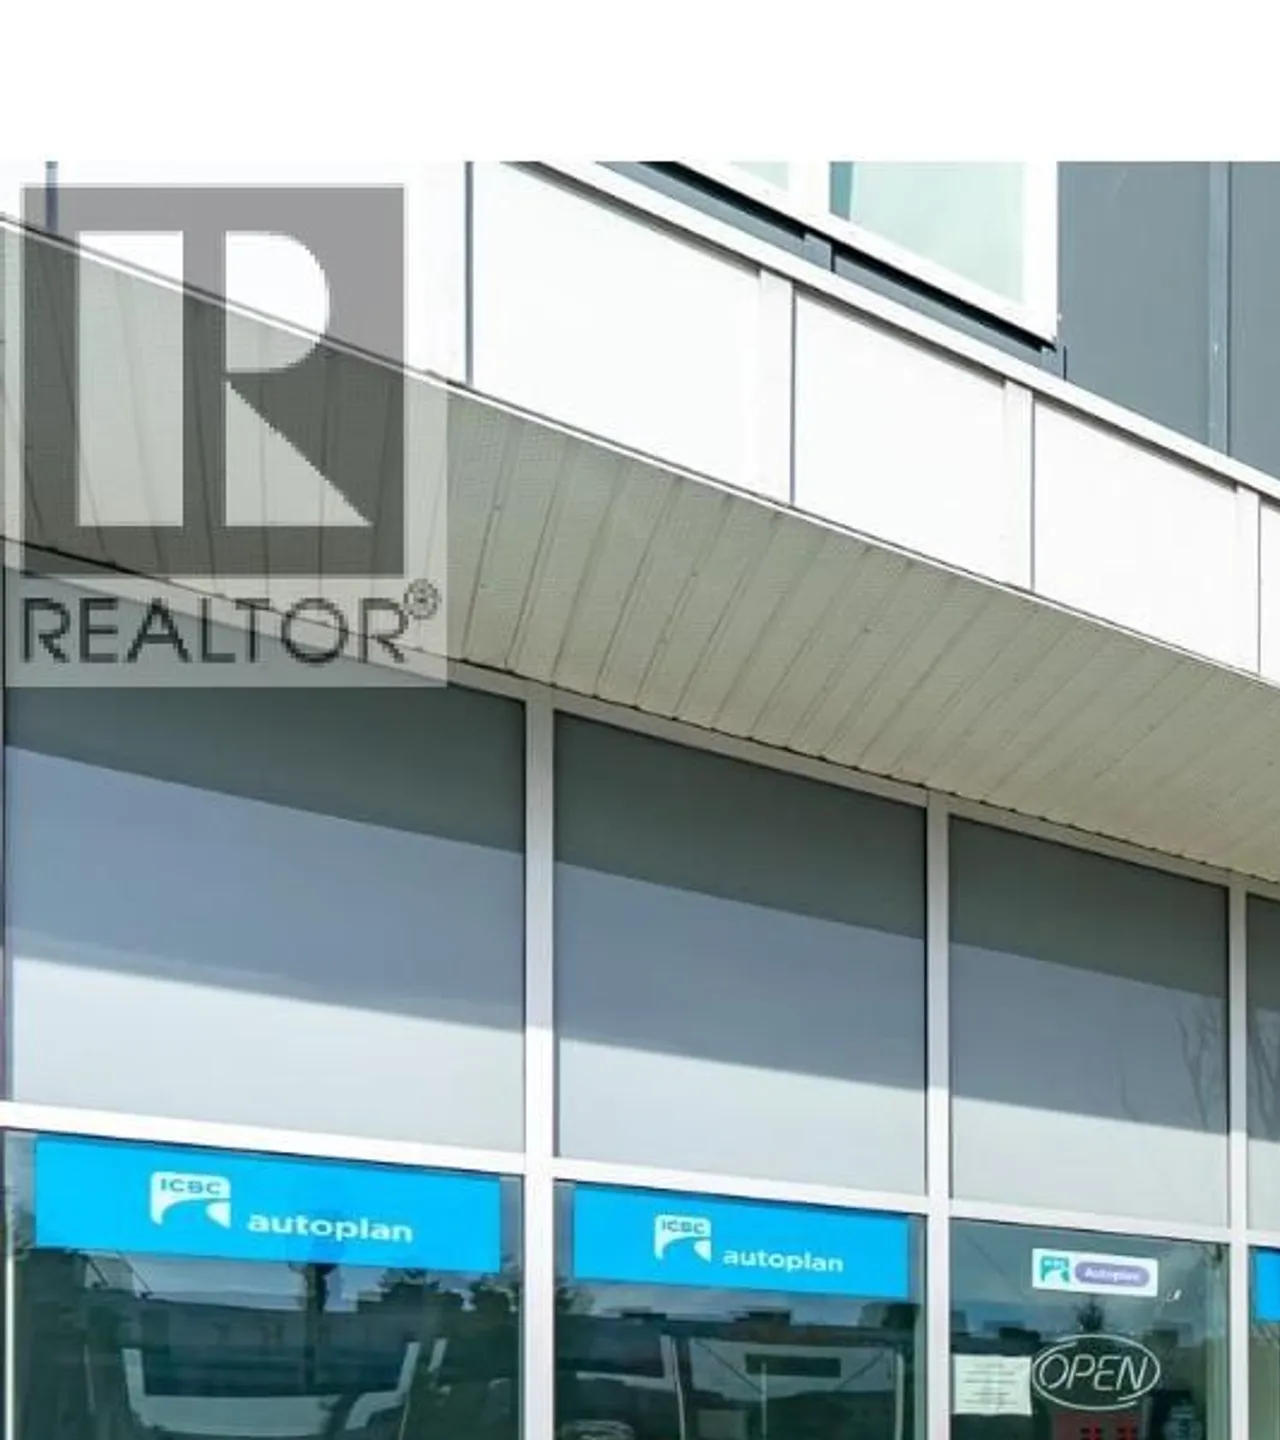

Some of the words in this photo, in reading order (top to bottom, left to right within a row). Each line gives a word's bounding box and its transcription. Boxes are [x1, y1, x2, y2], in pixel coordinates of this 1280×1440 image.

[160, 1178, 222, 1194] ICBC
[247, 1213, 414, 1243] autoplan
[662, 1219, 706, 1235] ICBC
[722, 1249, 845, 1273] autoplan
[1039, 1353, 1148, 1391] OPEN
